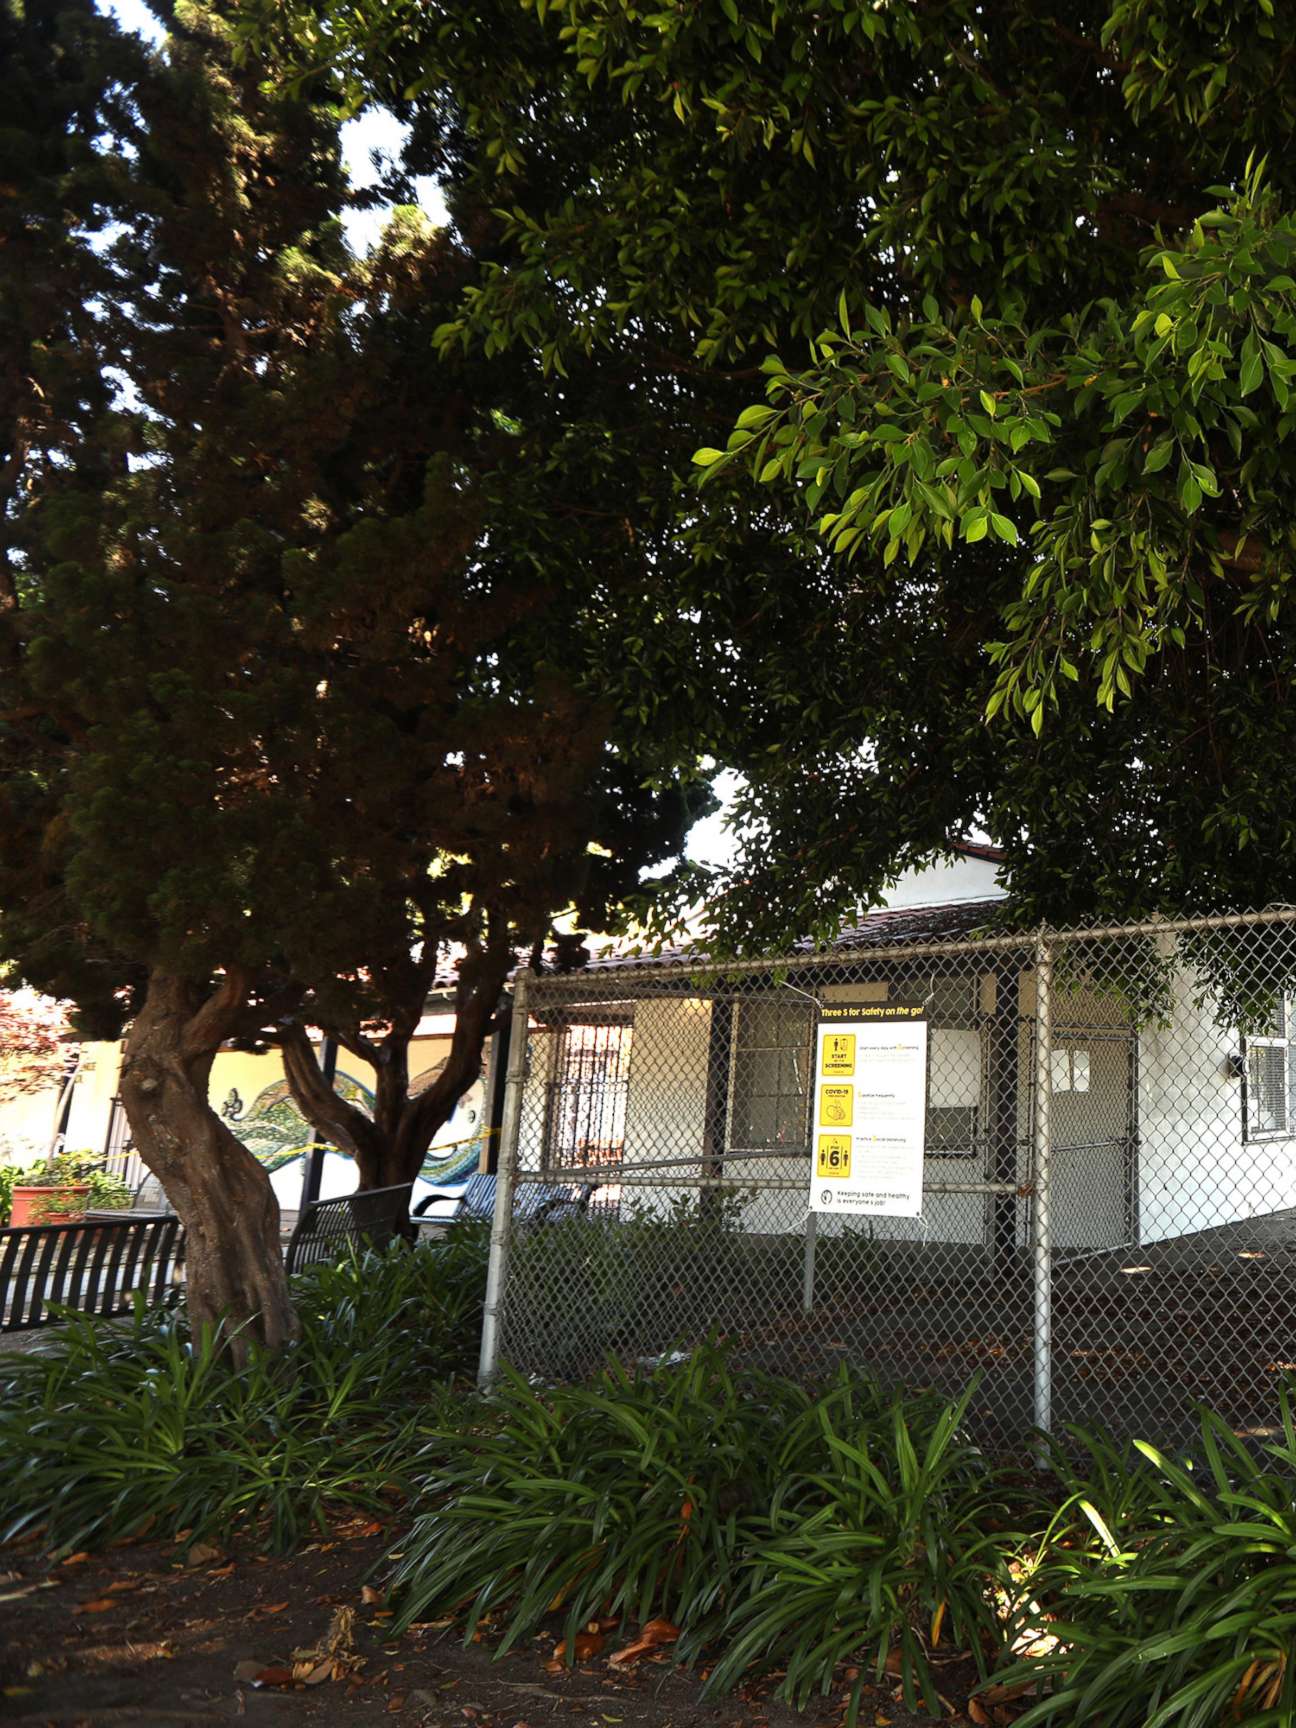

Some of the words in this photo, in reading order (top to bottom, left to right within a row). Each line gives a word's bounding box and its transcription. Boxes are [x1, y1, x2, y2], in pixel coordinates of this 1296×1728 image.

[821, 1008, 842, 1017] Three
[843, 1008, 848, 1017] S
[849, 1008, 860, 1017] for
[861, 1007, 885, 1018] Safety
[886, 1007, 896, 1016] on
[896, 1006, 909, 1015] the
[829, 1150, 840, 1167] 6
[837, 1190, 860, 1198] Keeping
[888, 1192, 910, 1200] healthy
